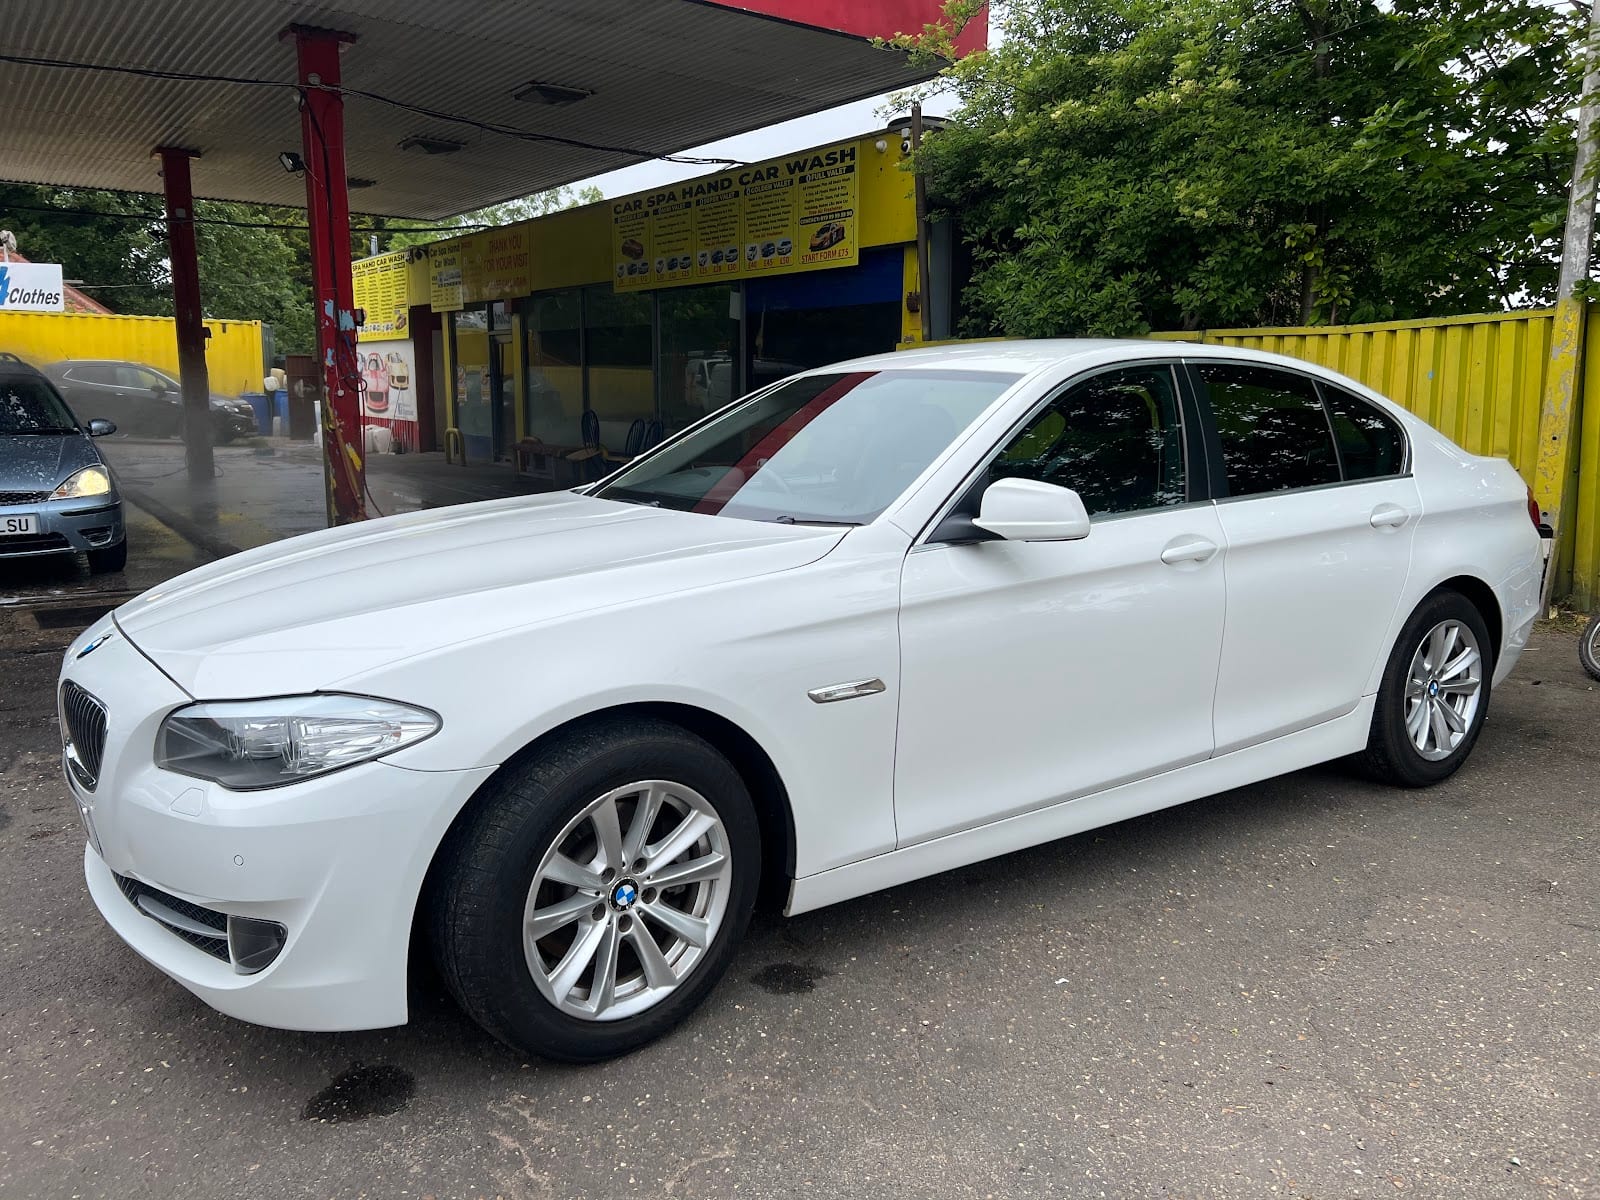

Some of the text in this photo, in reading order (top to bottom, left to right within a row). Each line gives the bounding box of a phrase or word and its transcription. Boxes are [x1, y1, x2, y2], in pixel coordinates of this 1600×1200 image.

[826, 167, 847, 177] VALET
[613, 146, 856, 215] CAR SPA HAND CAR WASH
[773, 180, 791, 189] VALET
[509, 232, 522, 249] YOU
[438, 246, 447, 256] Spa
[801, 248, 849, 263] START FORM £75
[362, 260, 376, 270] HAND
[376, 256, 387, 266] CAR
[388, 253, 405, 263] WASH
[434, 257, 456, 268] Car Wash
[496, 256, 513, 271] YOUR
[514, 253, 528, 268] VISIT
[9, 288, 60, 305] Clothes
[0, 518, 29, 532] SU
